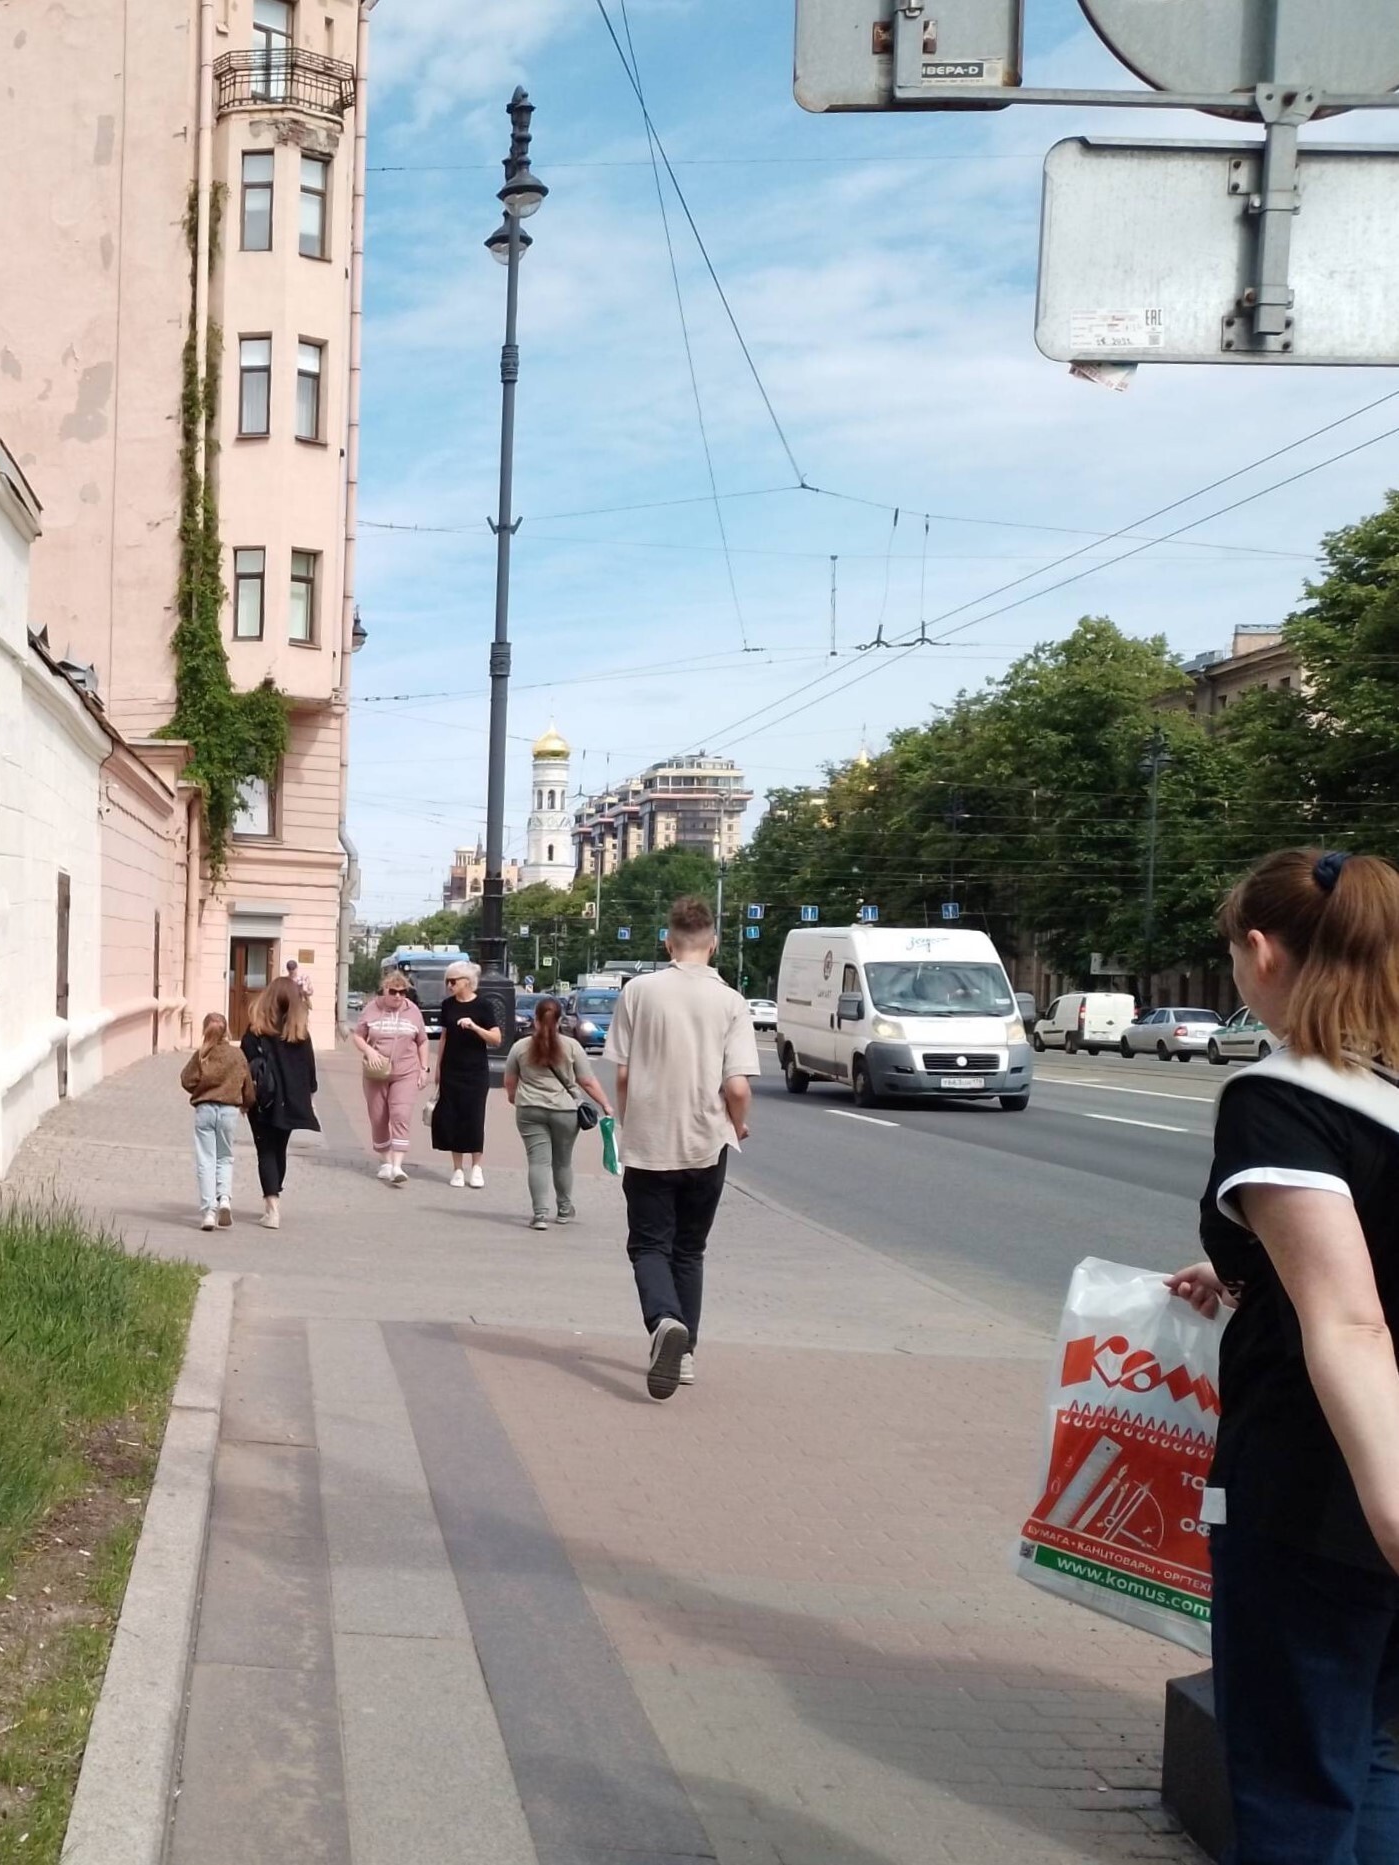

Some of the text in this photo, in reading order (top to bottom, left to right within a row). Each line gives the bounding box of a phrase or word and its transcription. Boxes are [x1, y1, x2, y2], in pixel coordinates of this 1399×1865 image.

[1027, 1524, 1071, 1546] БУМАГА
[1076, 1540, 1156, 1575] КАНЦТОВАРЫ
[1056, 1556, 1212, 1619] www.komus.com
